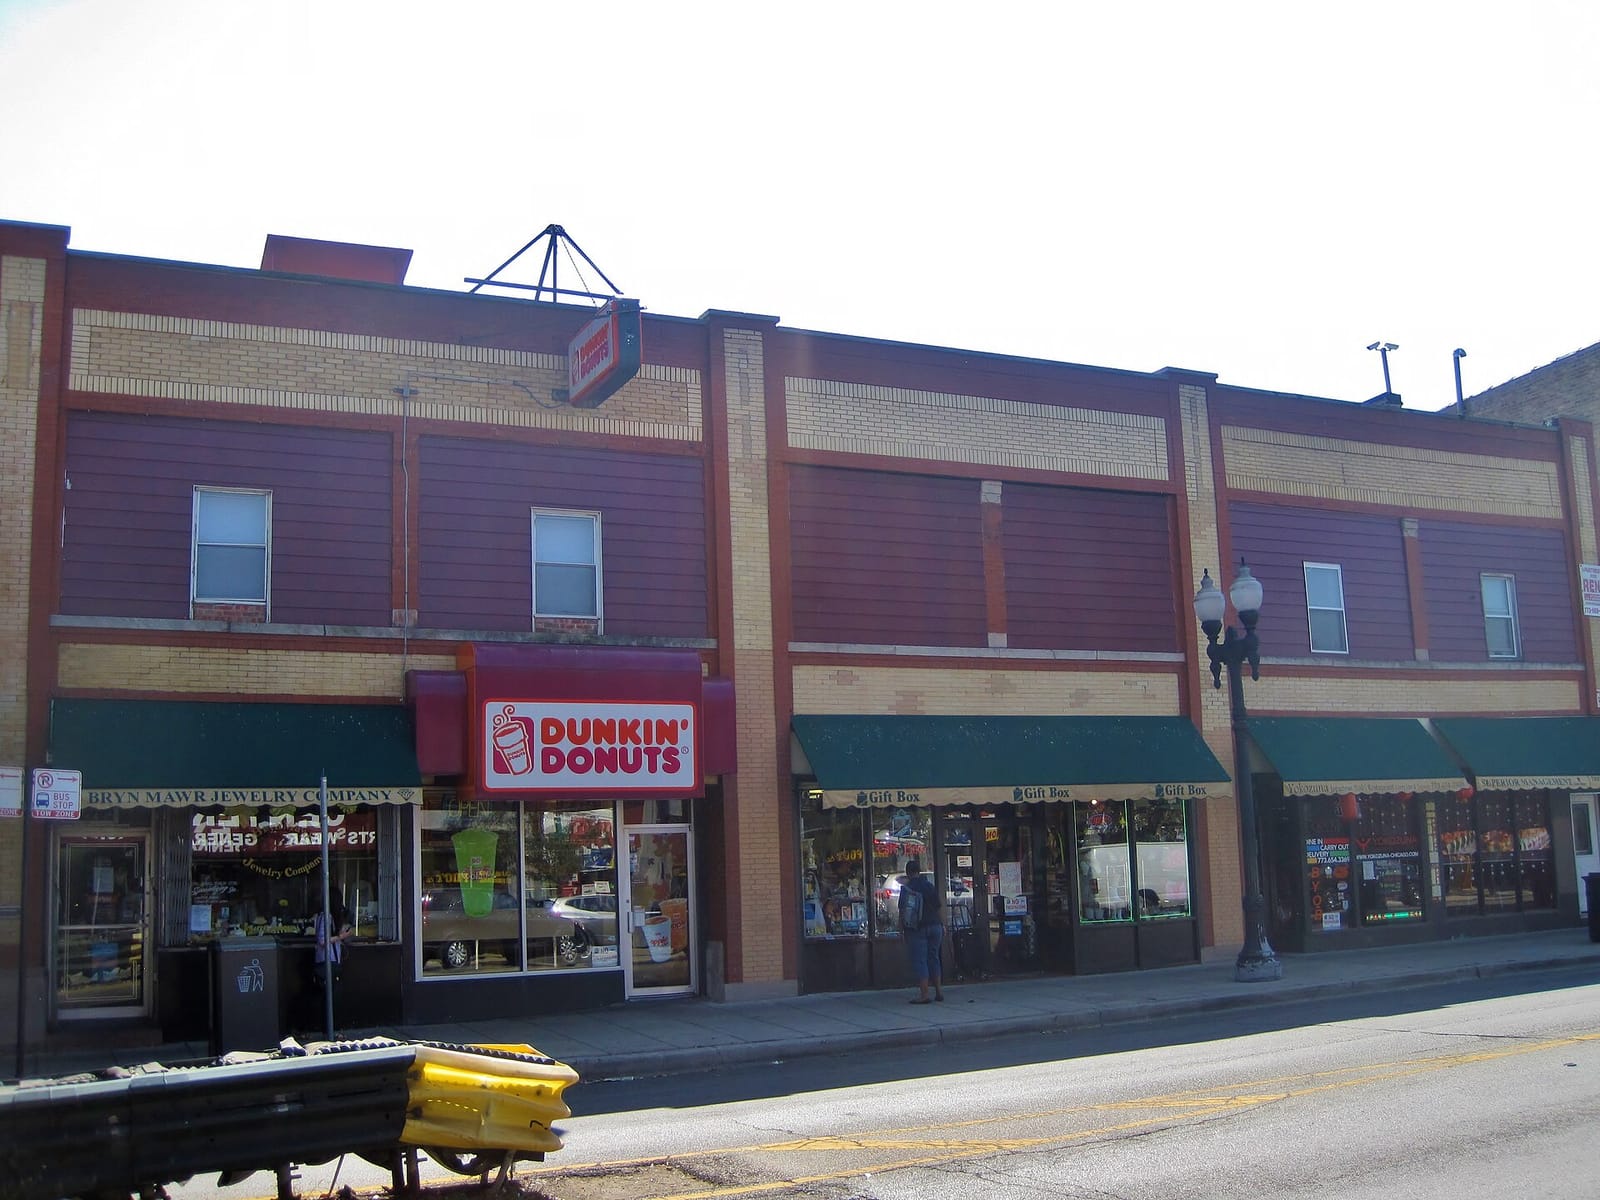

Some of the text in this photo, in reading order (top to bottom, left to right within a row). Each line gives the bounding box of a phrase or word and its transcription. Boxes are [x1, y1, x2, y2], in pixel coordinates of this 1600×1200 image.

[540, 717, 689, 746] DUNKIN'
[540, 746, 681, 774] DONUTS
[88, 789, 391, 804] BRYN MAWR JEWELRY COMPANY
[869, 790, 920, 803] Gift Box
[1024, 787, 1070, 799] Gift Box
[1165, 784, 1207, 796] Gift Box
[242, 857, 284, 880] Jewelry
